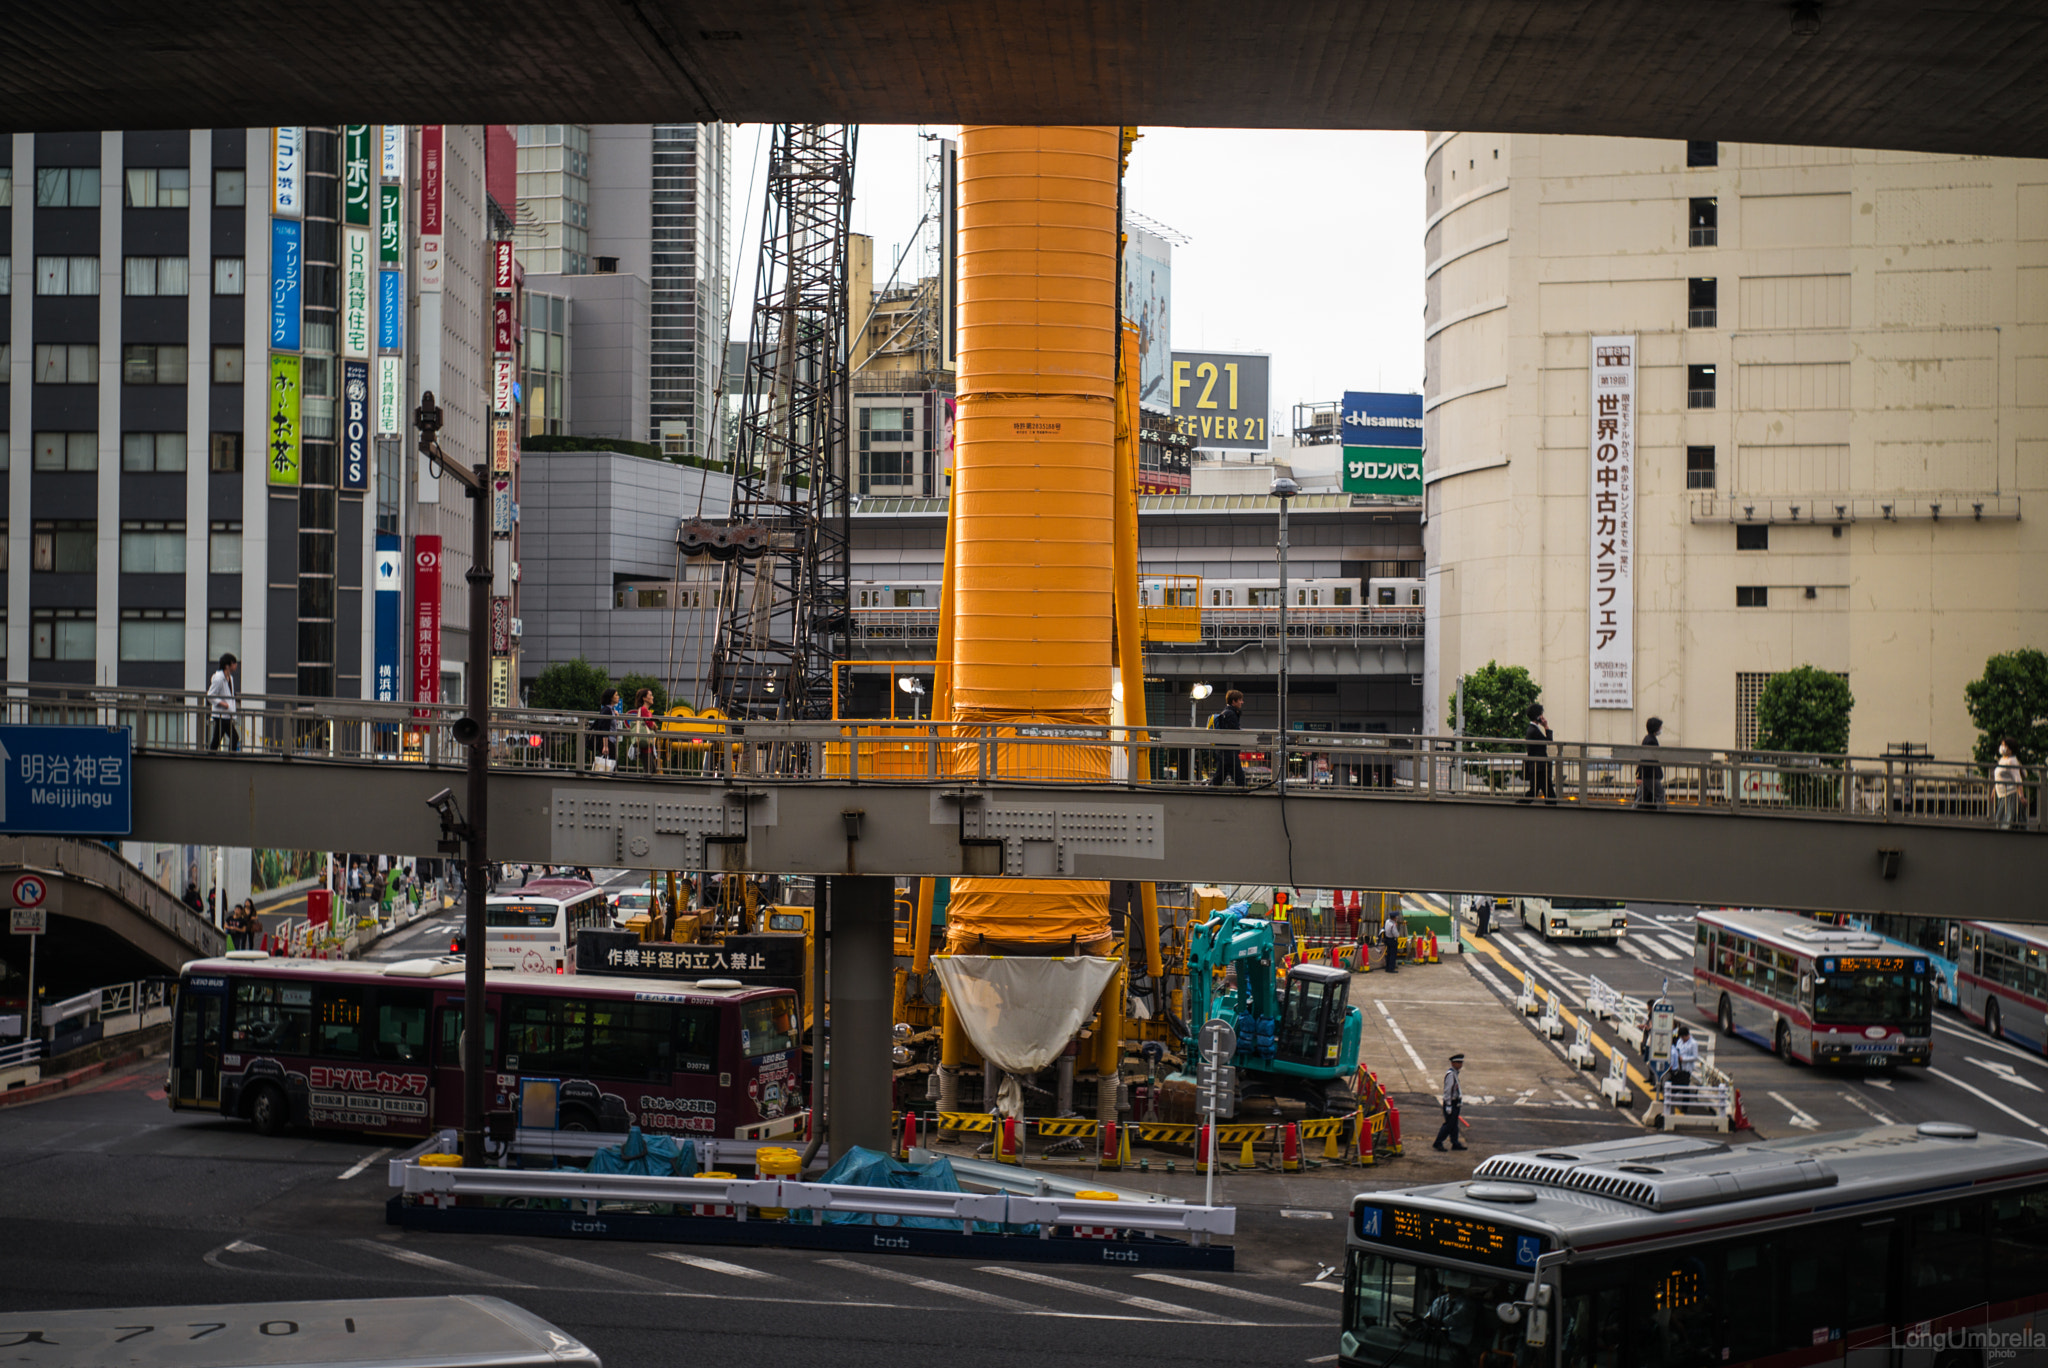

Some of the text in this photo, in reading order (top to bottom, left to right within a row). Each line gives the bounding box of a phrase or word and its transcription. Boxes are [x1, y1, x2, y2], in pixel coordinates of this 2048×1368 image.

[286, 241, 297, 293] アリシア
[498, 244, 511, 286] カラオケ
[274, 278, 286, 343] クリニック
[348, 235, 366, 352] UR賃貸住宅
[384, 274, 394, 344] アリシアクリニック
[382, 360, 394, 430] UR賃貸住宅
[497, 363, 509, 410] アデランス
[1172, 361, 1238, 410] F21
[1244, 417, 1265, 441] 21
[1346, 411, 1422, 428] Hisamitsu
[349, 401, 363, 482] BOSS
[497, 430, 508, 470] 鹿島学園高校
[1348, 461, 1421, 481] サロンパス
[1597, 393, 1620, 650] 世界の中古カメラフェア
[21, 755, 122, 785] 明治神宮
[32, 788, 112, 808] Meijijingu
[607, 948, 767, 971] 作業半径内立入禁止
[208, 978, 224, 987] BUS
[310, 1066, 428, 1095] ヨドバシカメラ
[115, 1317, 357, 1343] 7701
